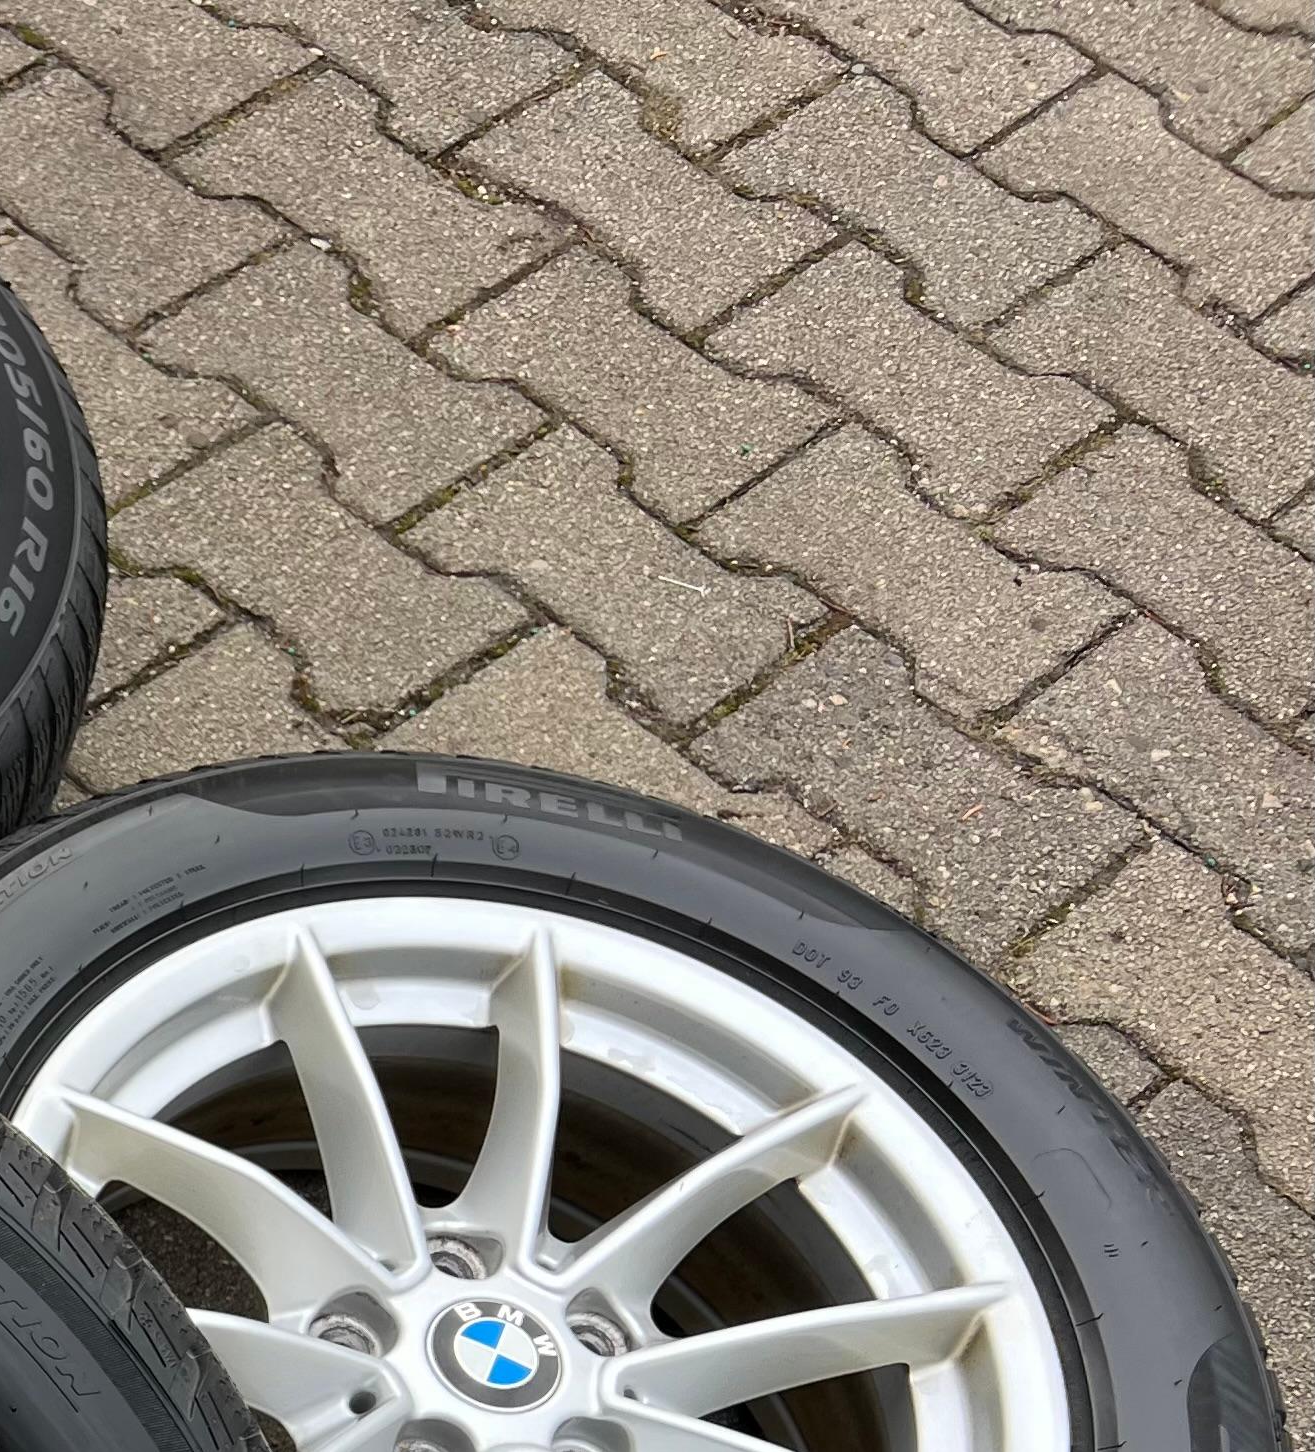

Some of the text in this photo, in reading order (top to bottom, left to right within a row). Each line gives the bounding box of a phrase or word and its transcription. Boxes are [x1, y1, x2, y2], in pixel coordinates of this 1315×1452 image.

[416, 762, 683, 842] PIRELLI
[792, 938, 831, 969] DOT
[452, 1302, 557, 1357] BMW
